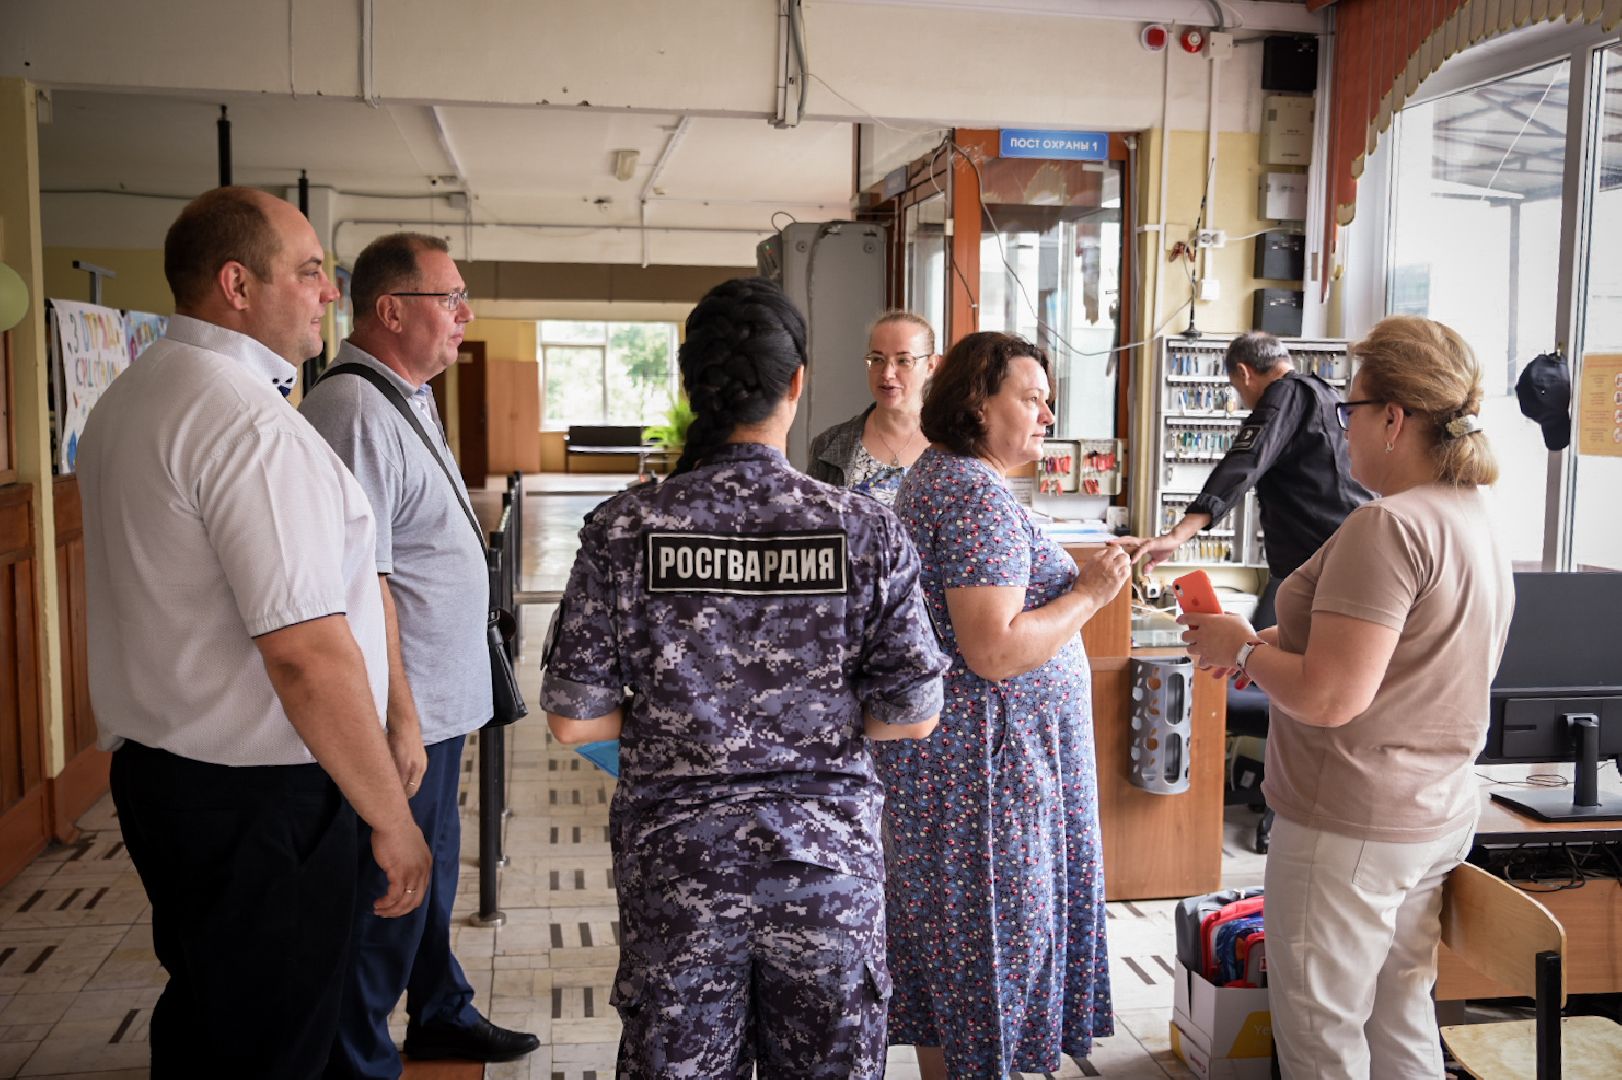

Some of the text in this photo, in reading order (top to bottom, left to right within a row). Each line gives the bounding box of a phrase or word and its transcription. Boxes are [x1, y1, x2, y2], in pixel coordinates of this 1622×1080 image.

[1010, 137, 1098, 152] ПОСТ ОХРАНЫ 1
[658, 546, 836, 584] РОСГВАРДИЯ
